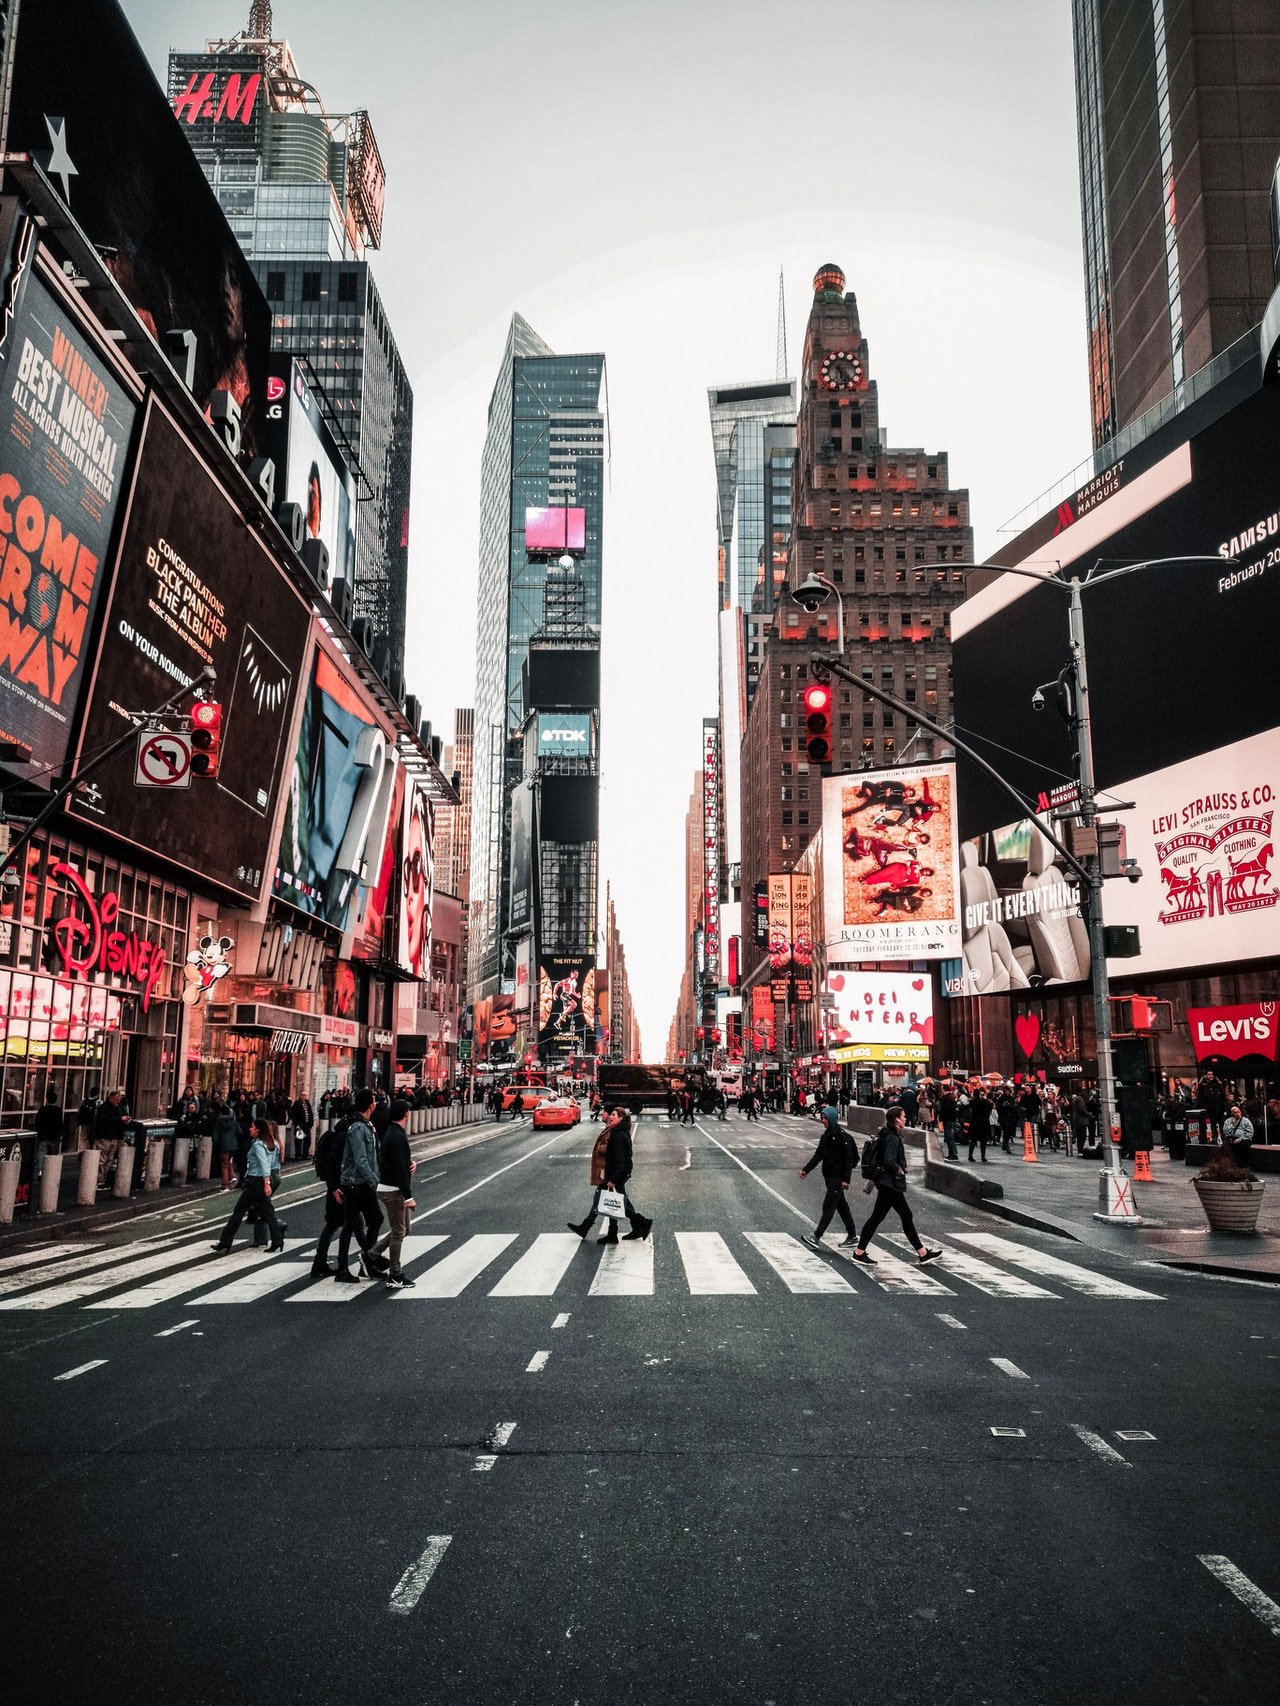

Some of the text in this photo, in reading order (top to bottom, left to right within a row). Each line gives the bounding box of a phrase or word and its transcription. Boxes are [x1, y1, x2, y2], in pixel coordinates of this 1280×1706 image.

[172, 73, 262, 125] H&M
[52, 325, 110, 424] WINNER!
[18, 337, 62, 411] BEST
[58, 384, 118, 483] MUSICAL
[266, 405, 283, 419] G
[12, 381, 28, 412] ALL
[29, 399, 61, 446] ACROSS
[60, 432, 85, 472] NORTH
[82, 458, 113, 503] AMERICA
[1077, 460, 1124, 503] MARRIOTT
[1077, 478, 1119, 516] MARQUIS
[0, 472, 98, 606] COME
[158, 538, 226, 618] CONGRATULATIONS
[1218, 559, 1266, 593] February
[146, 546, 228, 643] BLACK PANTHER
[148, 599, 214, 665] MUSIC FROM AND INSPIRED BY
[157, 579, 215, 651] THE ALBUM
[119, 619, 207, 704] ON YOUR NOMINATON
[11, 683, 26, 698] STORY
[25, 693, 38, 706] NOW
[36, 700, 45, 710] ON
[44, 704, 67, 723] BROADWAY
[552, 729, 587, 742] TDK
[1051, 779, 1081, 796] MARRIOTT
[1051, 789, 1078, 805] MARQUIS
[1152, 784, 1276, 835] LEVI STRAUSS & CO.
[1189, 813, 1231, 829] SAN FRANCISCO
[1160, 819, 1269, 859] ORIGINAL RIVETED
[1223, 837, 1257, 854] CLOTHING
[1172, 852, 1198, 869] QUALITY
[771, 900, 789, 911] KING
[772, 892, 787, 900] LION
[965, 881, 1081, 930] GIVE IT EVERYTHING
[1247, 901, 1256, 909] 20
[840, 923, 959, 941] BOOMERANG
[1165, 911, 1201, 923] PATENTED
[273, 1029, 303, 1053] FOREVER
[884, 1048, 907, 1058] NEW
[1058, 1064, 1079, 1073] swatch
